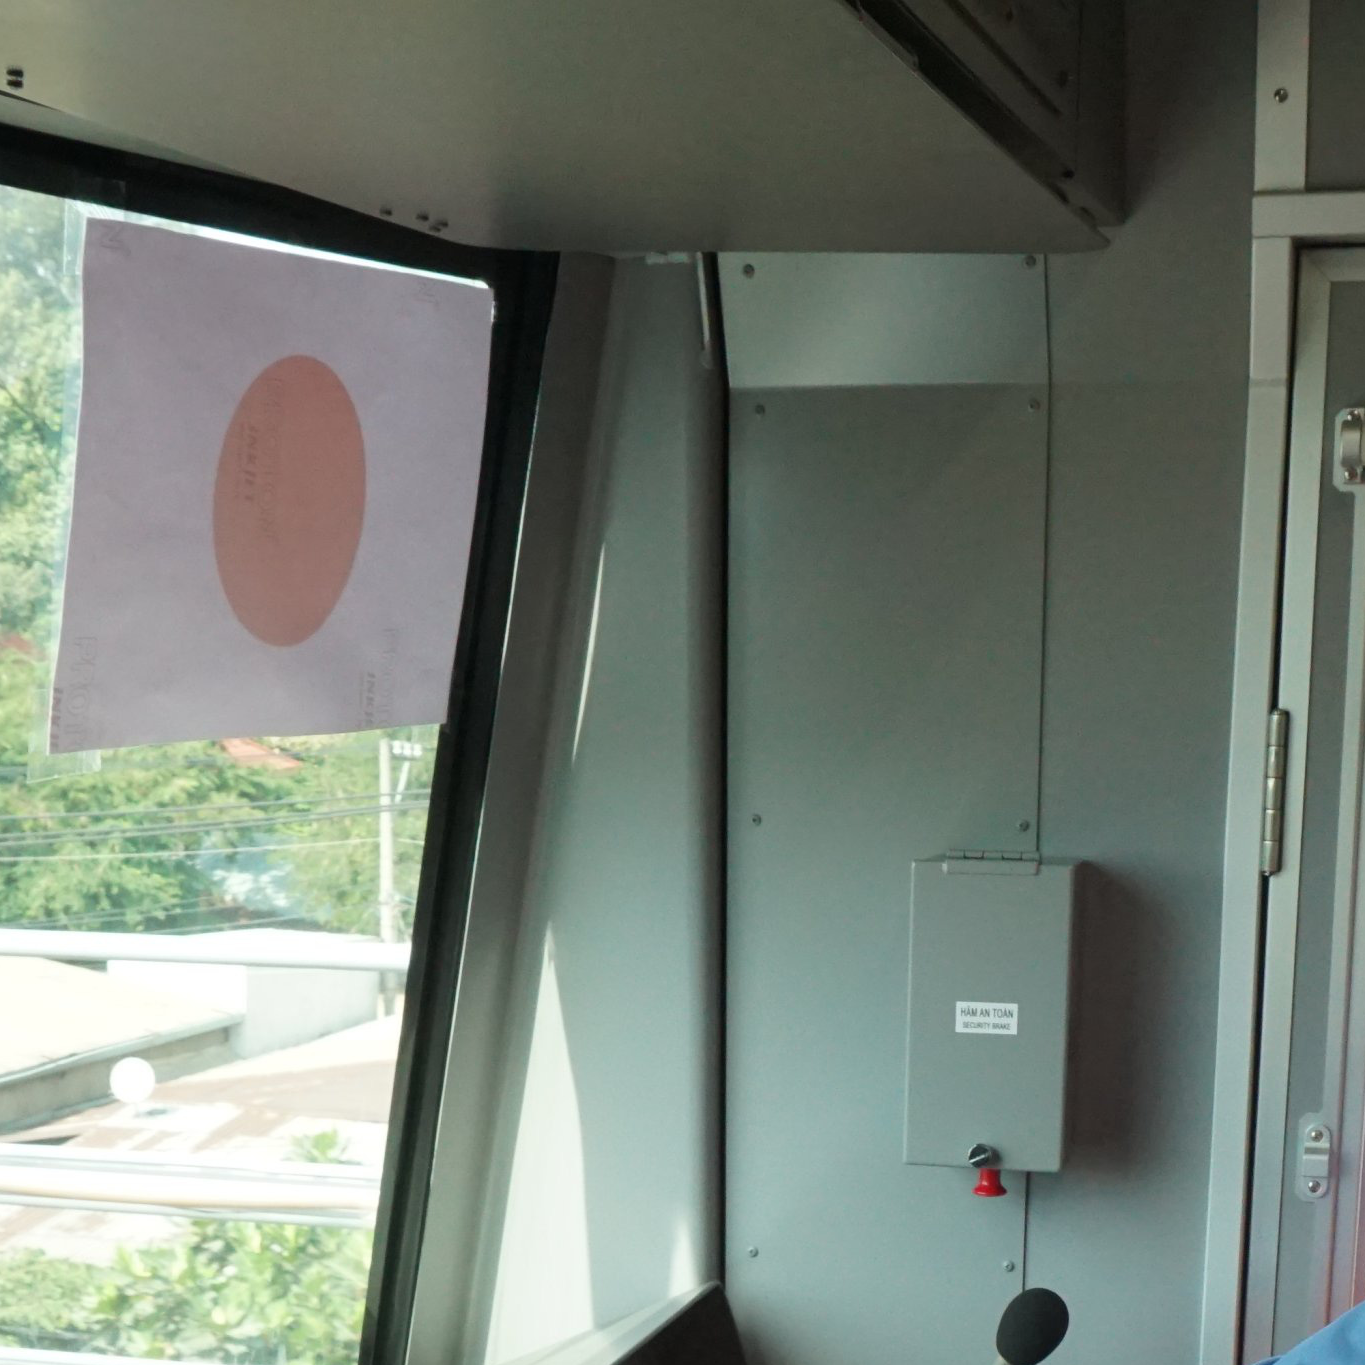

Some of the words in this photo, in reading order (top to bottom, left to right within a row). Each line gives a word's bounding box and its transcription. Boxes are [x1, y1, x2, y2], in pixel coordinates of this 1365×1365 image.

[979, 1007, 990, 1017] AN
[962, 1021, 990, 1031] SECURITY
[992, 1022, 1011, 1030] BRAKE
